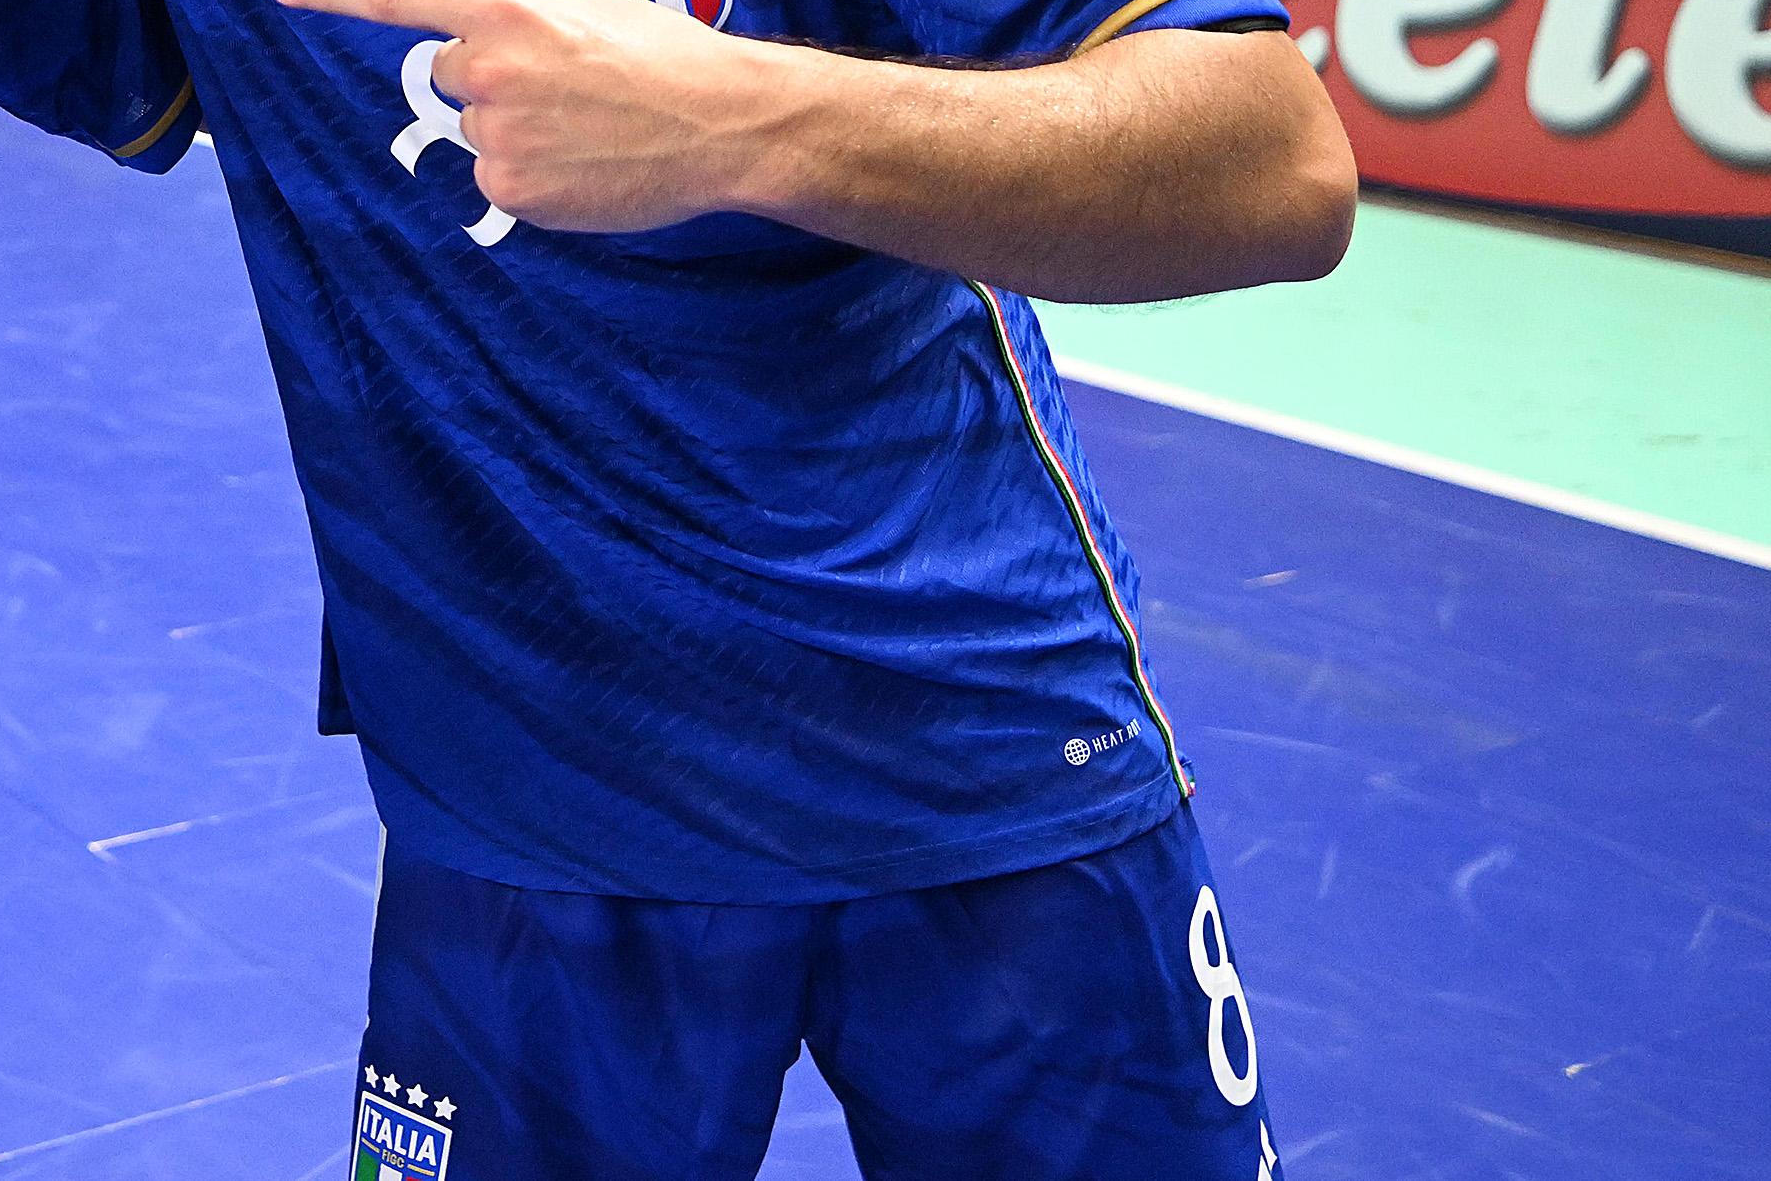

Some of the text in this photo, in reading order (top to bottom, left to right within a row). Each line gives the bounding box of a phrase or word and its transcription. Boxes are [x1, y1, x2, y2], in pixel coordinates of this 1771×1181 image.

[1189, 884, 1258, 1107] 8
[362, 1104, 436, 1166] ITALIA
[381, 1148, 405, 1168] FIGC
